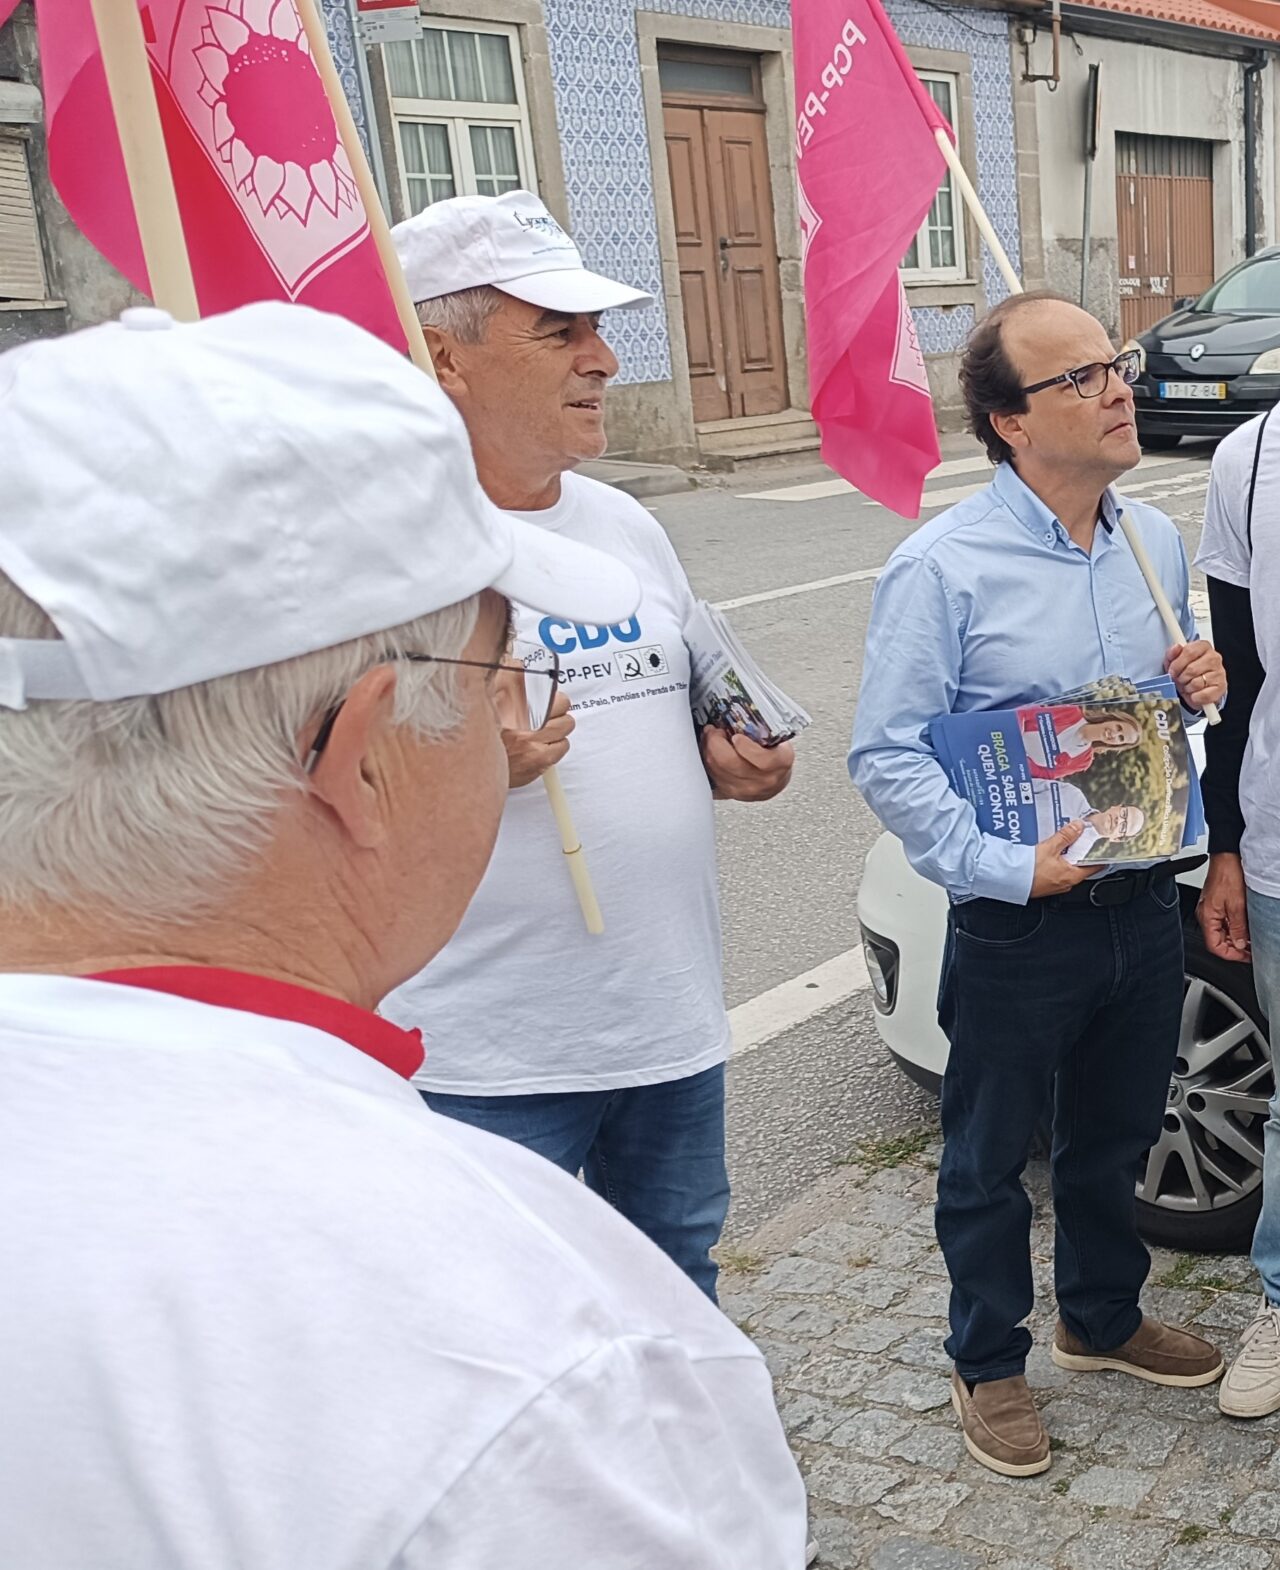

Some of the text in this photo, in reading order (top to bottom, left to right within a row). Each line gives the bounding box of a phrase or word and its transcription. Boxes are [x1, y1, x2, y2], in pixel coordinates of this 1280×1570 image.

[538, 614, 641, 654] CDU
[557, 662, 612, 685] CP-PEV
[610, 691, 641, 704] Panóias
[646, 685, 669, 696] Parada
[669, 683, 676, 692] de
[1154, 710, 1171, 741] CDU
[978, 744, 998, 781] QUEM
[988, 784, 1005, 831] CONTA
[991, 731, 1021, 843] BRAGA SABE COM
